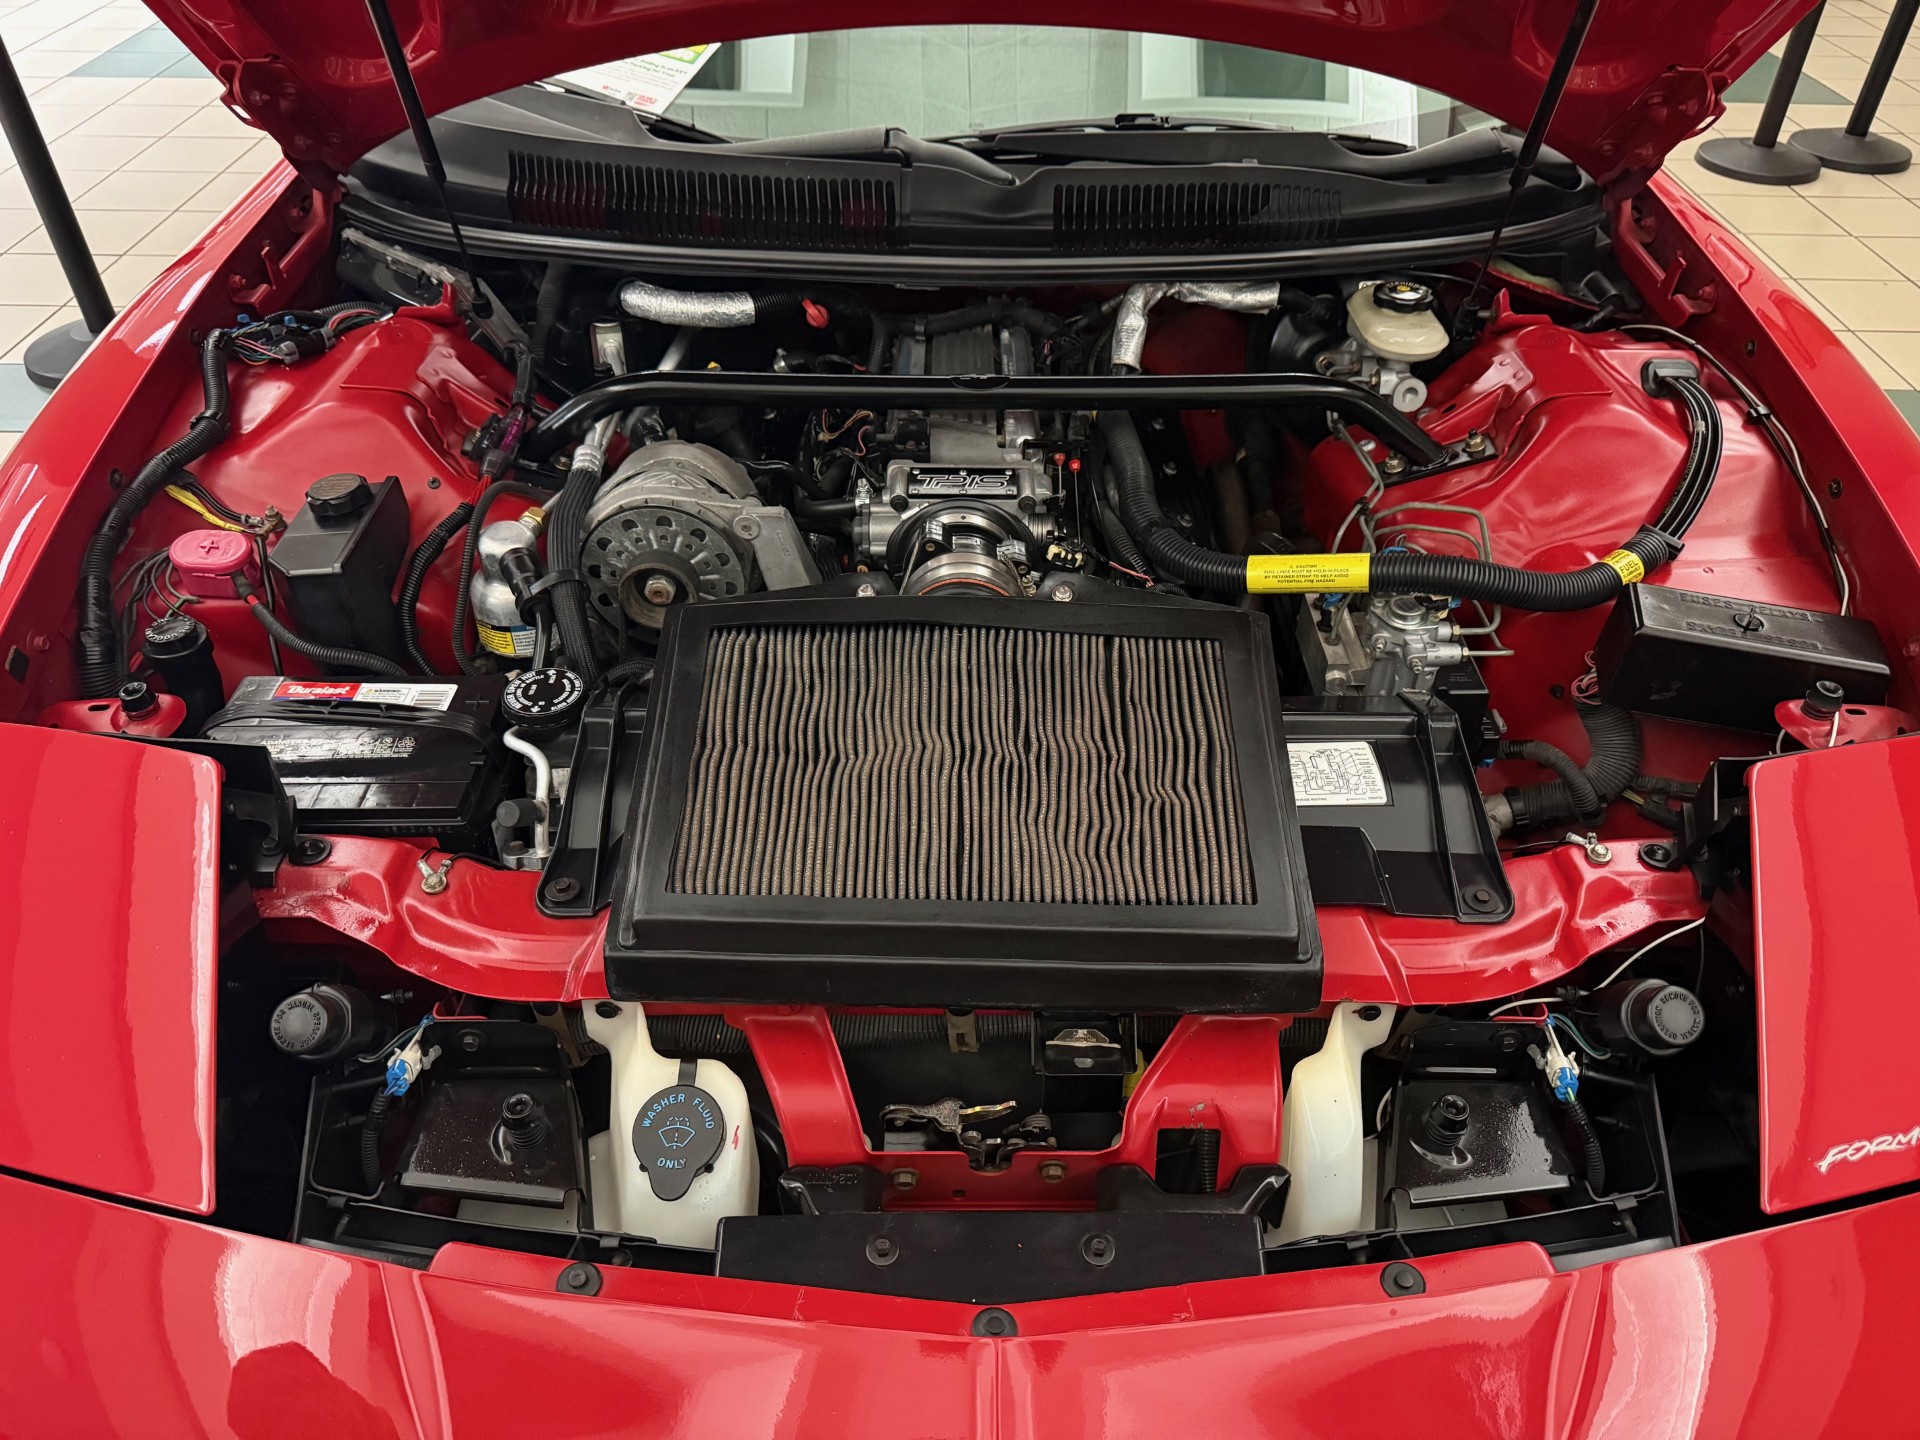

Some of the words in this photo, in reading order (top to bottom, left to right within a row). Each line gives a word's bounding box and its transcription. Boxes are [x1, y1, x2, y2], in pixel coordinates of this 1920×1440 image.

[917, 474, 1010, 489] TPIS
[1619, 558, 1638, 574] FUEL
[1679, 592, 1733, 610] FUSES
[520, 671, 536, 681] HOT
[286, 686, 350, 694] Duralast
[506, 680, 522, 694] OPEN
[506, 694, 524, 710] NEVER
[287, 1000, 314, 1012] MANUAL
[274, 1009, 286, 1024] FOR
[300, 1012, 321, 1048] OPERATION
[642, 1094, 685, 1128] WASHER
[692, 1098, 715, 1129] FLUID
[1814, 1126, 1920, 1175] FORM
[657, 1157, 686, 1169] ONLY
